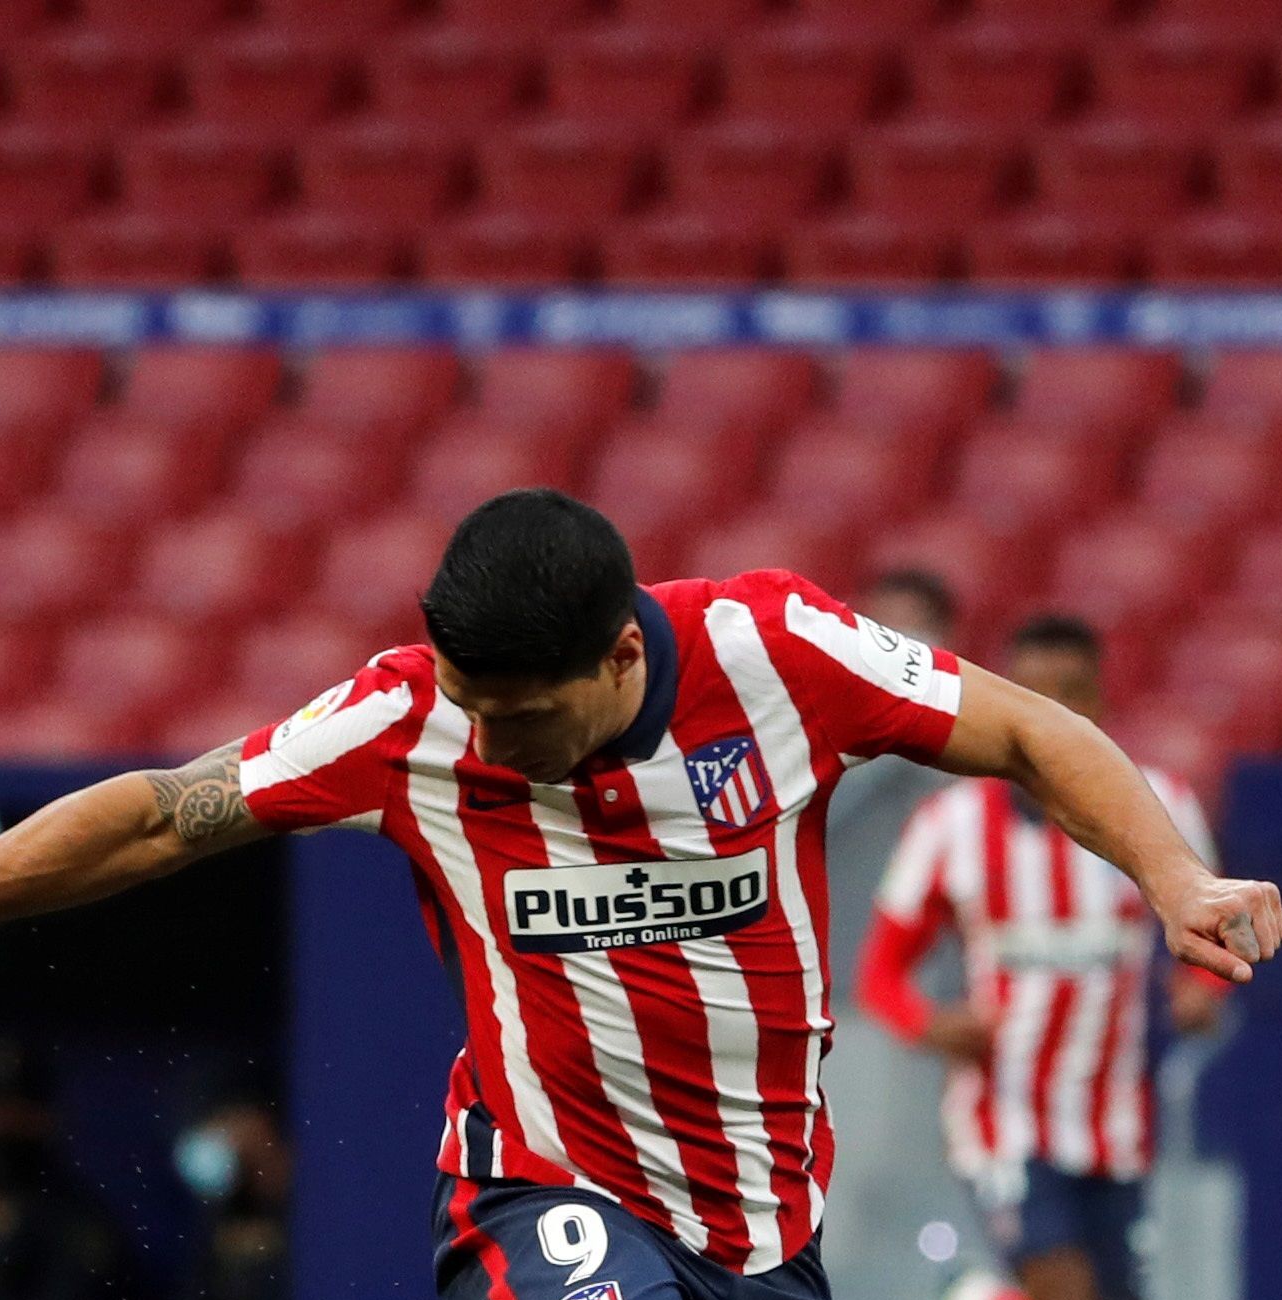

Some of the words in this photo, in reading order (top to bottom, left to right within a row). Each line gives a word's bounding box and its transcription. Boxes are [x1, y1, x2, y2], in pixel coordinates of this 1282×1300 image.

[514, 868, 761, 930] Plus500
[583, 929, 636, 949] Trade
[641, 925, 703, 943] Online
[536, 1203, 609, 1287] 9
